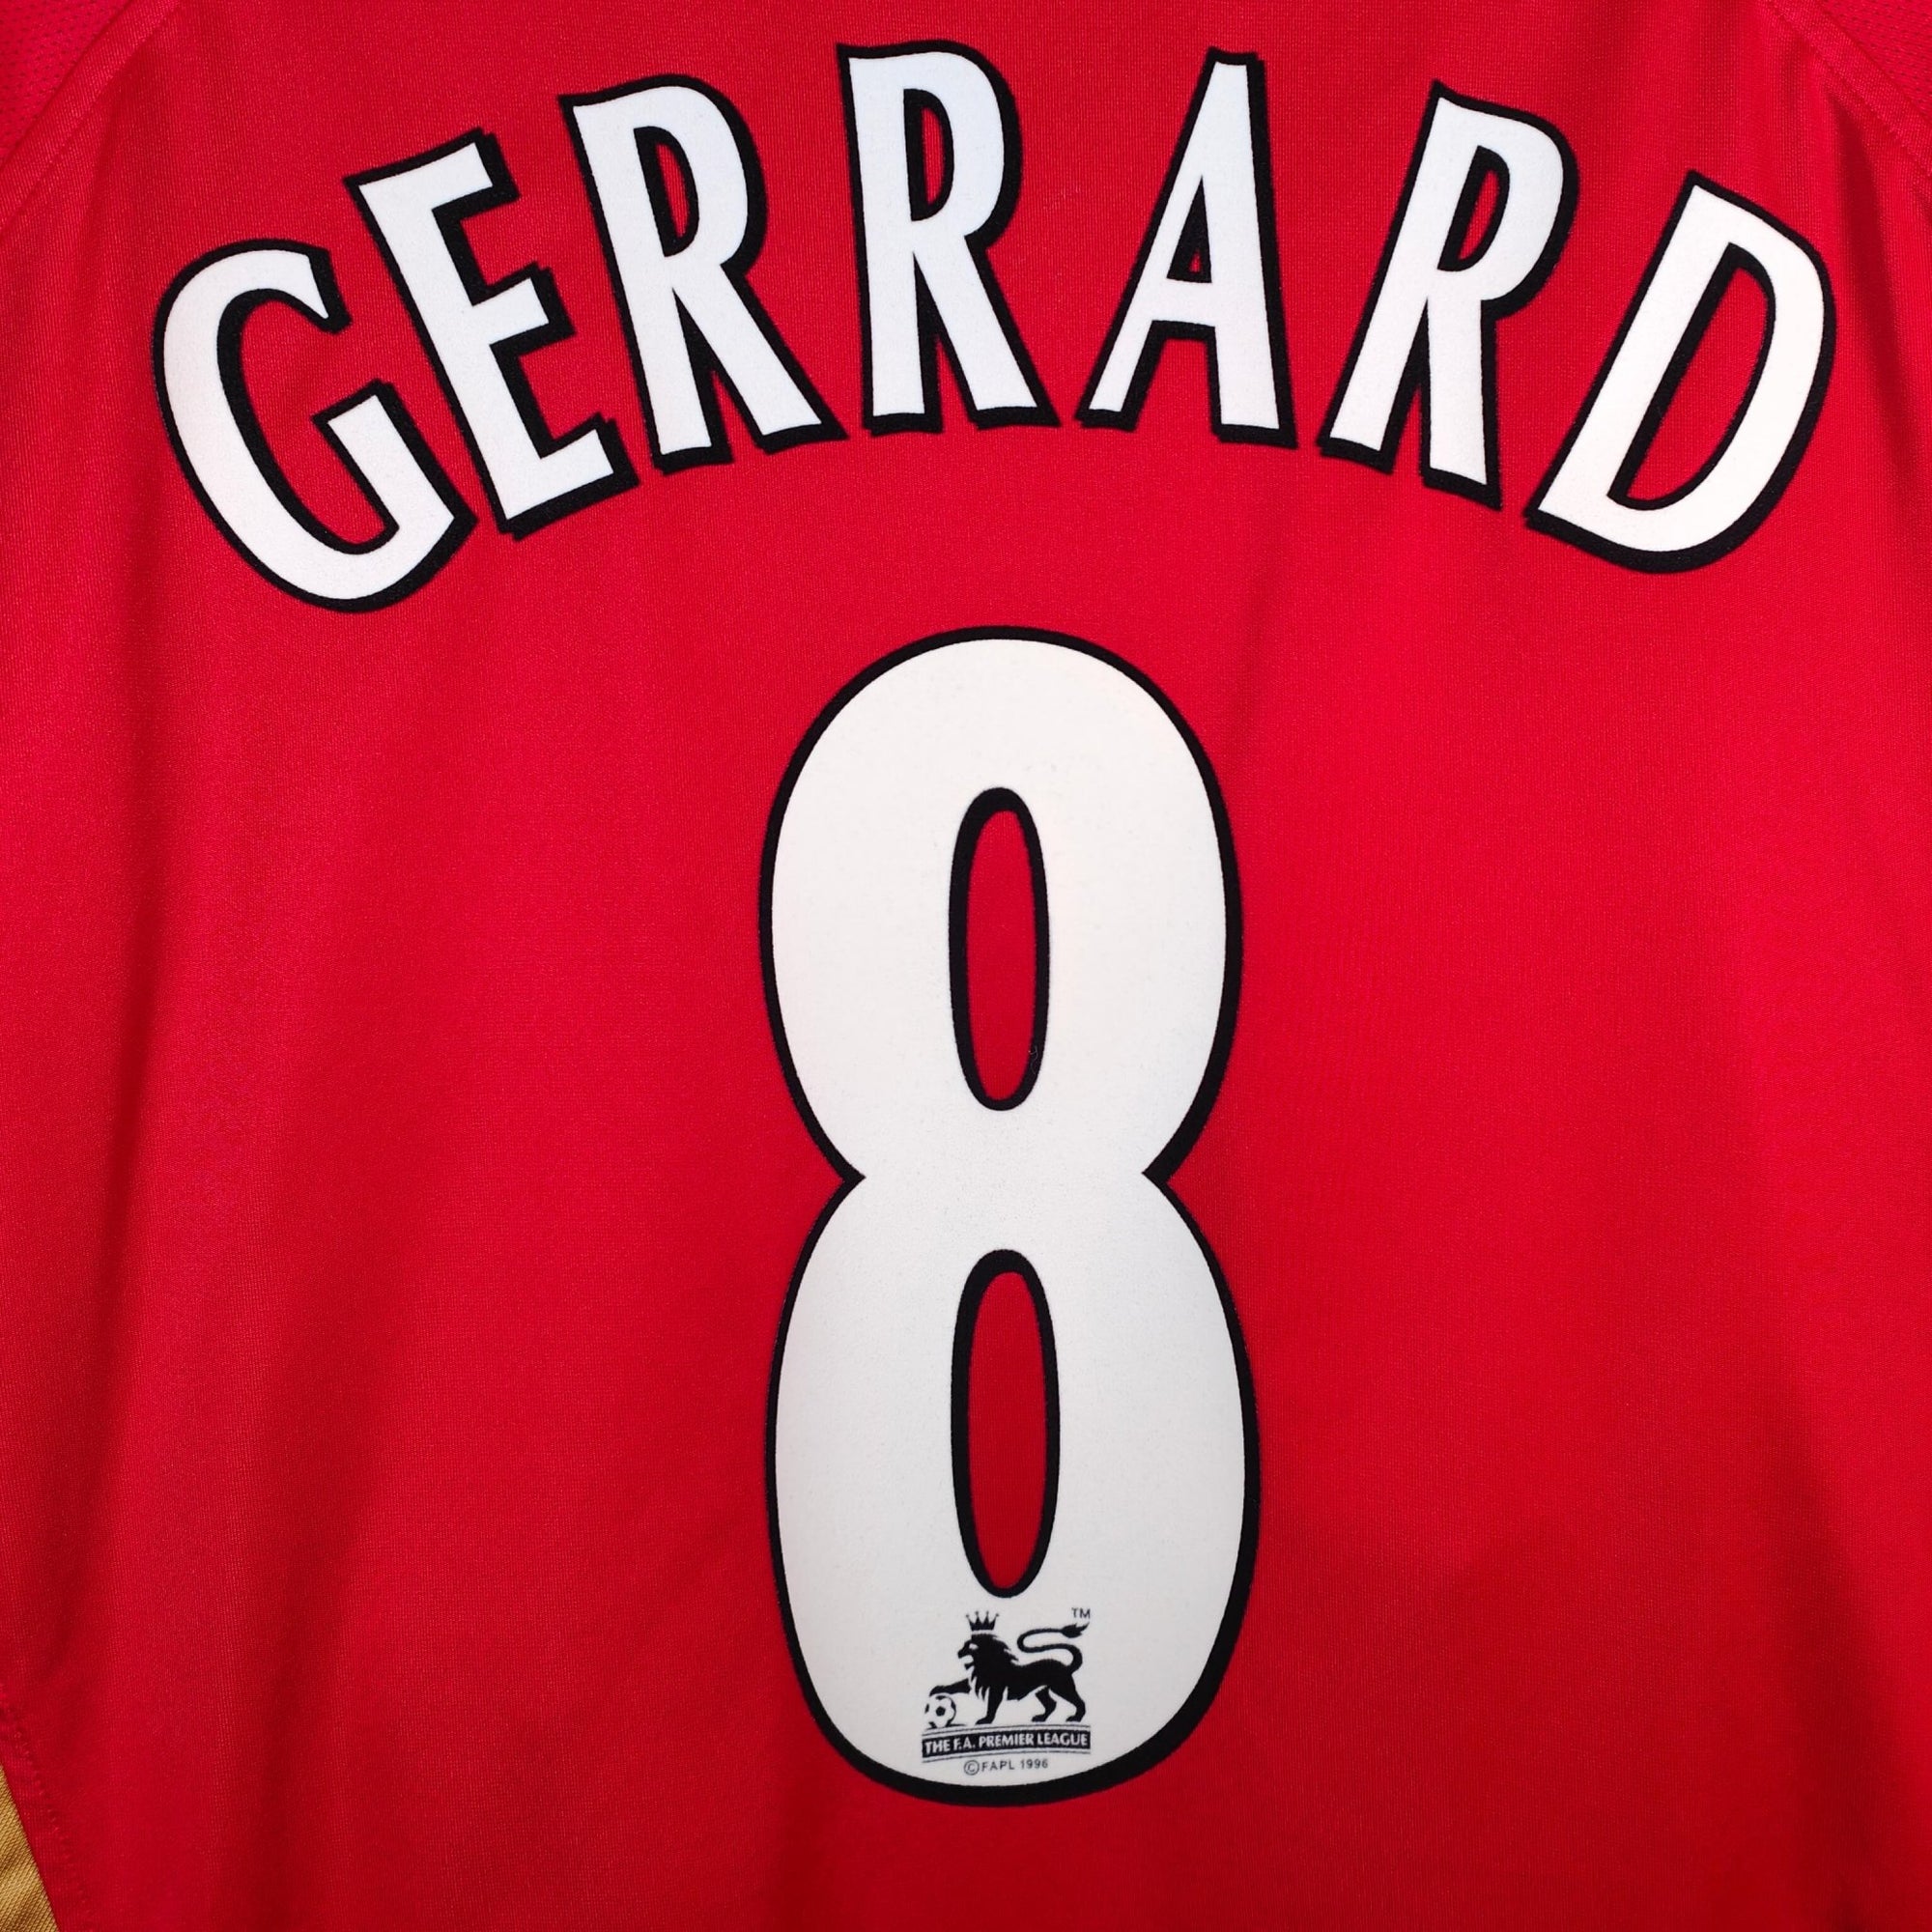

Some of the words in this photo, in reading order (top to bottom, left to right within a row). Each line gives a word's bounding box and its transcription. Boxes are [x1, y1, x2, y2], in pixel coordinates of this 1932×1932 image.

[153, 41, 1835, 612] GERRARD
[759, 627, 1261, 1806] 8
[1071, 1607, 1091, 1619] TM
[924, 1740, 951, 1754] THE
[953, 1738, 976, 1750] F.A.
[979, 1732, 1035, 1747] PREMIER
[1037, 1732, 1089, 1746] LEAGUE
[1020, 1758, 1048, 1770] 1996
